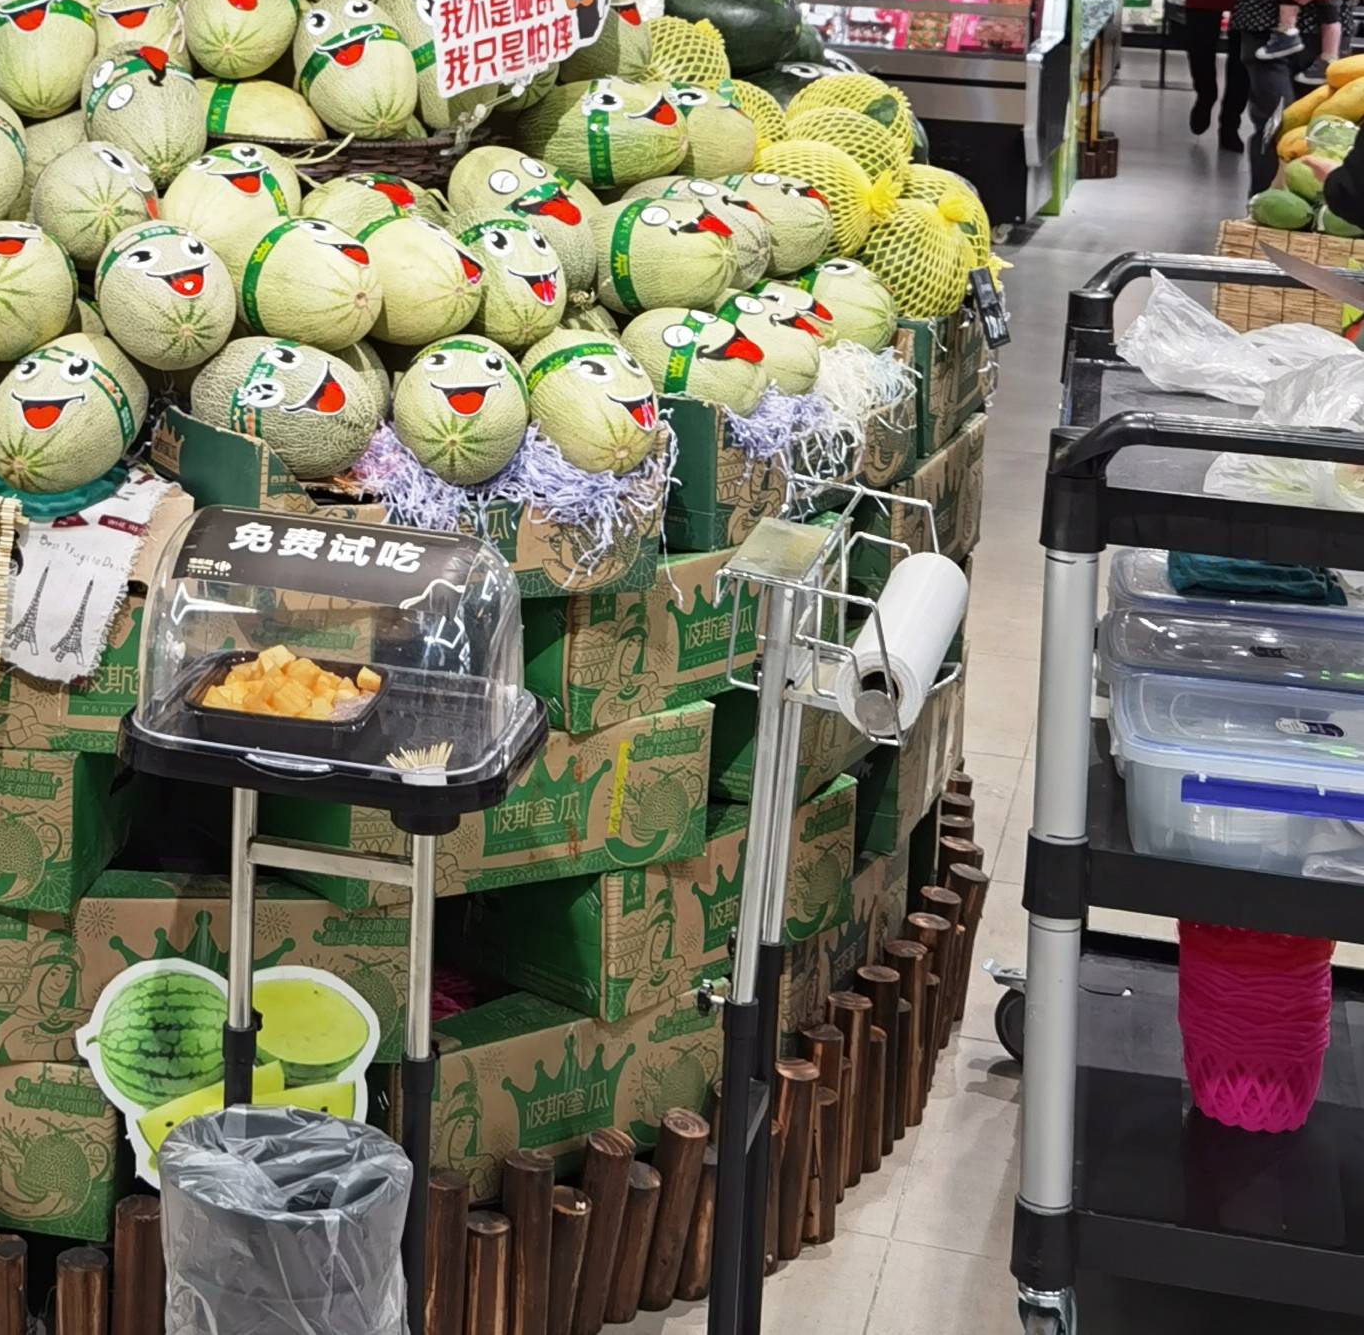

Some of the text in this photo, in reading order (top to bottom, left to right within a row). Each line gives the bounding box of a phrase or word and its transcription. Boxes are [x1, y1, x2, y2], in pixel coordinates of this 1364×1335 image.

[444, 14, 574, 91] 我只是怕摔
[228, 521, 426, 574] 免费试吃
[492, 791, 582, 835] 波斯蜜瓜
[526, 1080, 611, 1129] 波斯蜜瓜
